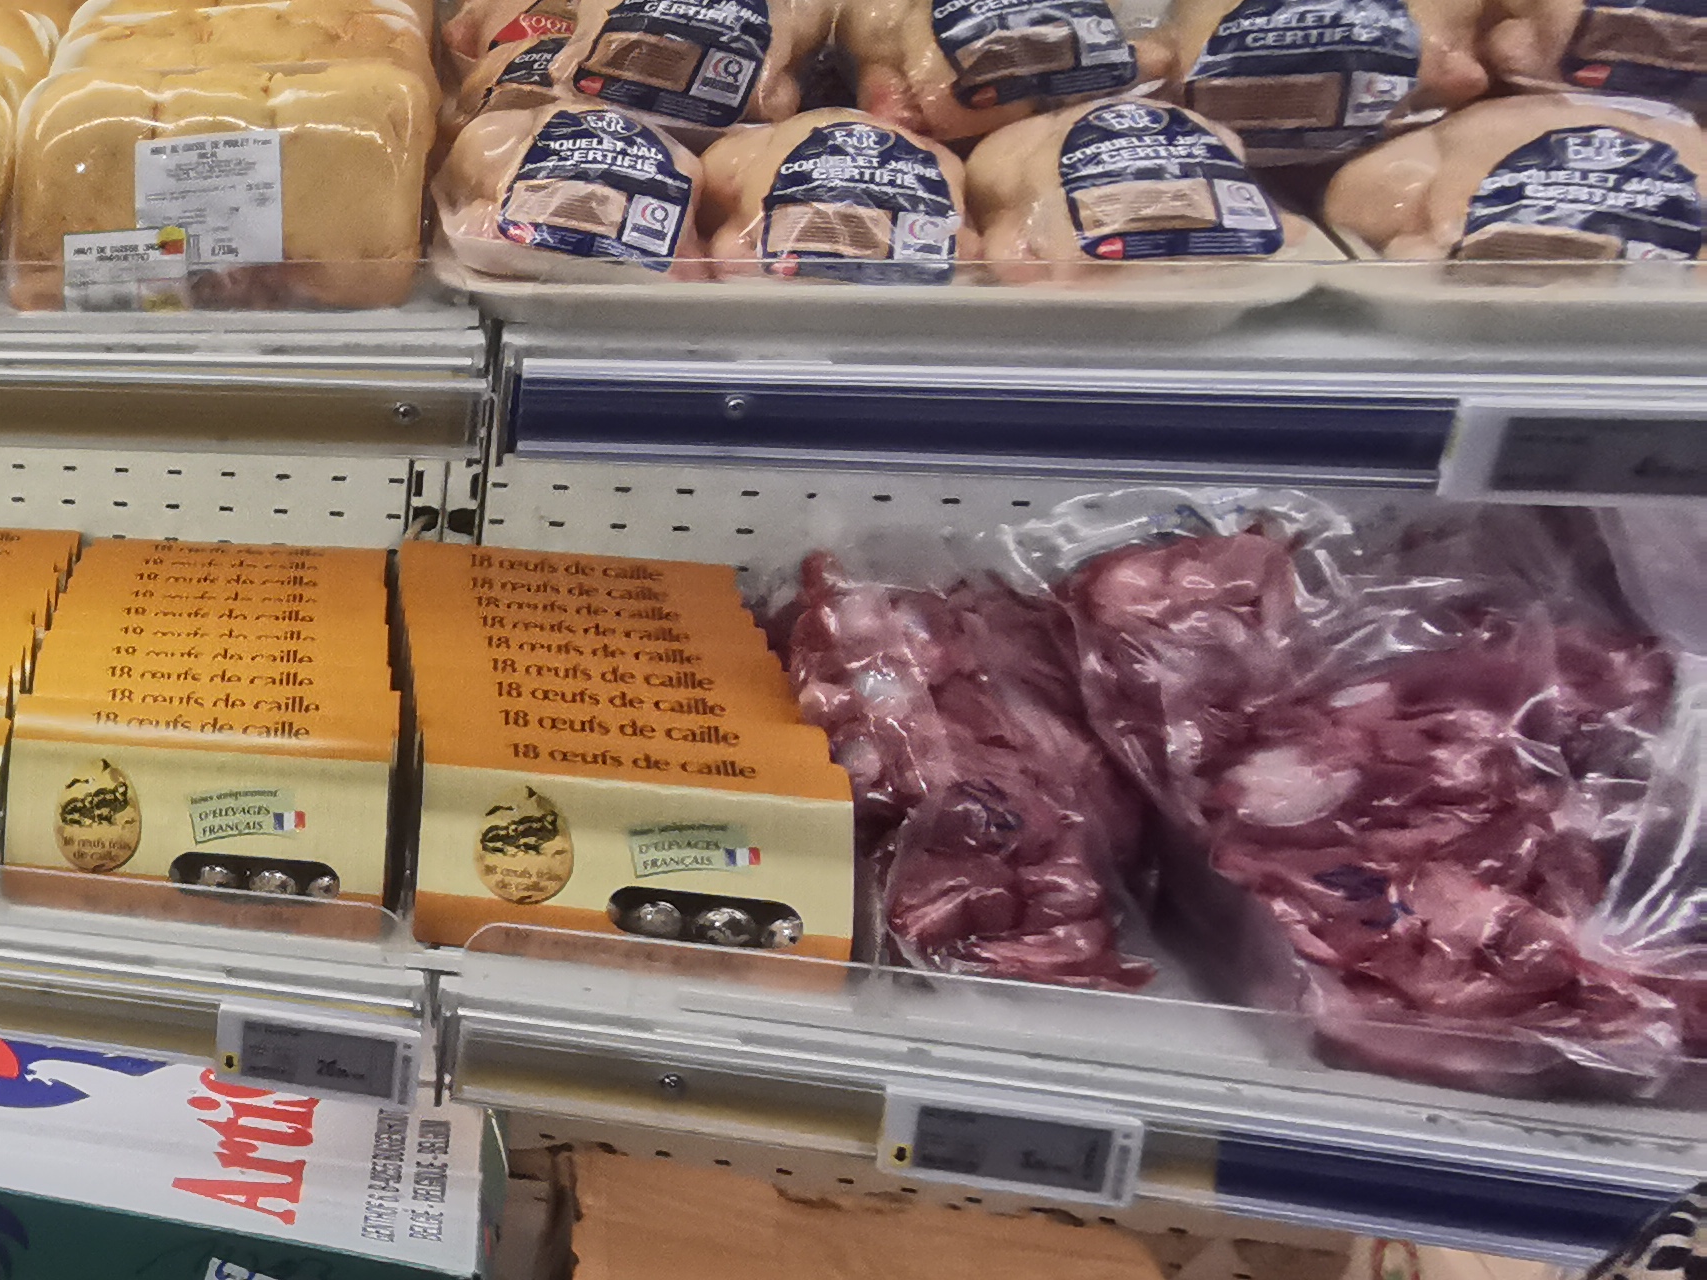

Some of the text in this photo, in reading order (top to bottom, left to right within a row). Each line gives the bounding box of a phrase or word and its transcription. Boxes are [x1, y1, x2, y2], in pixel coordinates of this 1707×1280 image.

[600, 665, 636, 685] de
[497, 681, 523, 698] 18
[608, 691, 645, 710] de
[654, 697, 727, 718] caille
[200, 717, 234, 734] de
[499, 708, 530, 728] 18
[619, 719, 657, 739] de
[665, 725, 740, 746] caille
[510, 742, 540, 759] 18
[632, 753, 671, 772] de
[681, 760, 757, 779] caille
